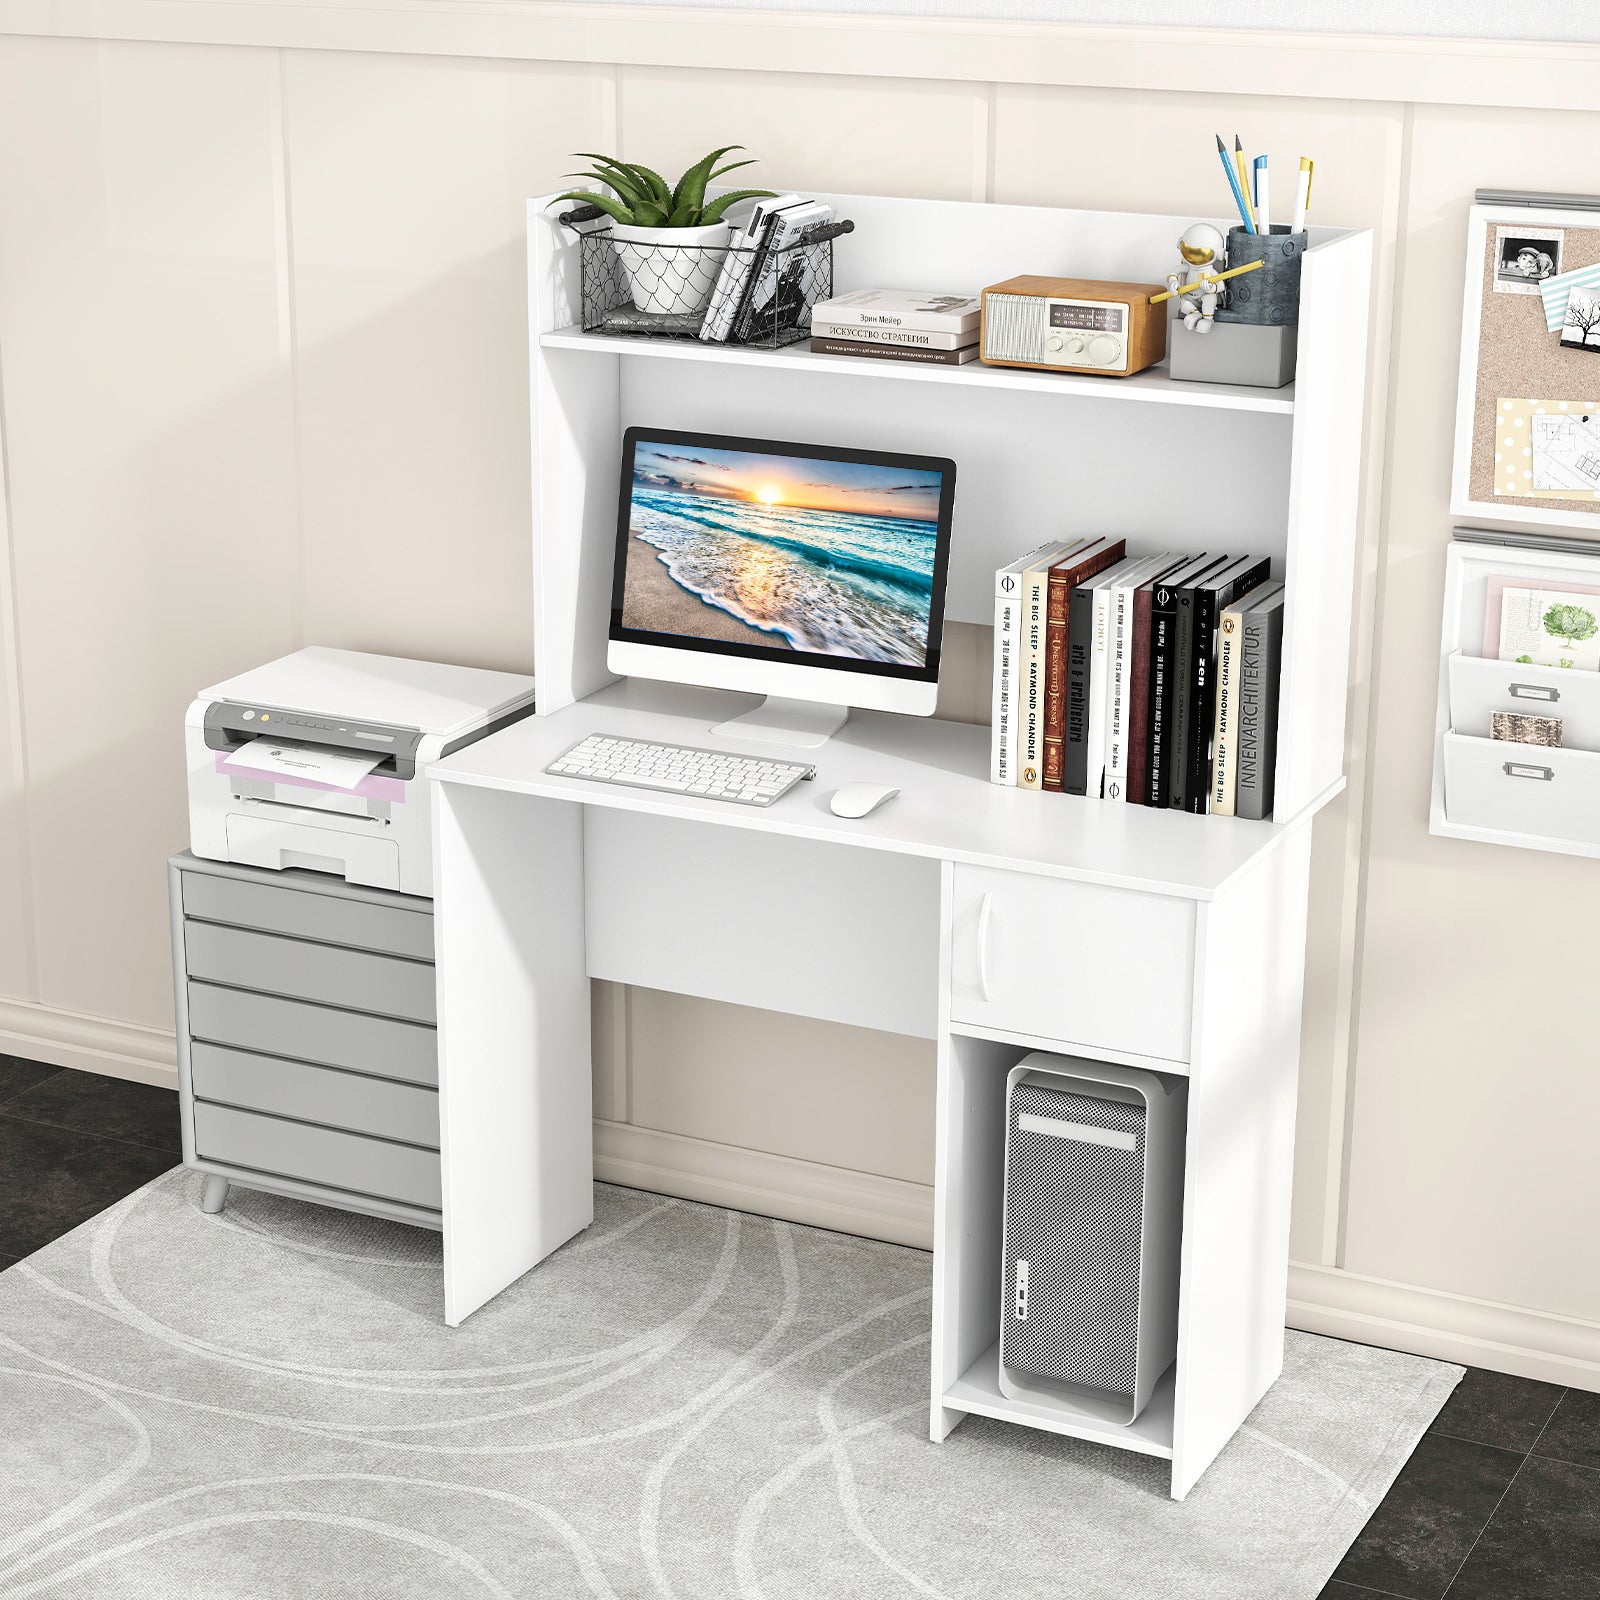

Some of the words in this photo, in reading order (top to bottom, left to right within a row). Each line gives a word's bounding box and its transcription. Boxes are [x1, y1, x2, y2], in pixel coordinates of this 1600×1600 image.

[830, 326, 879, 340] ИСКУССТВО
[881, 332, 929, 344] СТРАТЕГИИ
[860, 314, 876, 323] Эрин
[879, 315, 902, 326] Мейер
[1072, 645, 1086, 665] arts
[1222, 640, 1230, 686] CHANDLER
[1048, 690, 1059, 727] JOURNEY
[1070, 681, 1085, 743] architecture
[1220, 689, 1228, 733] RAYMOND
[1241, 626, 1260, 789] INNENARCHITEKTUR
